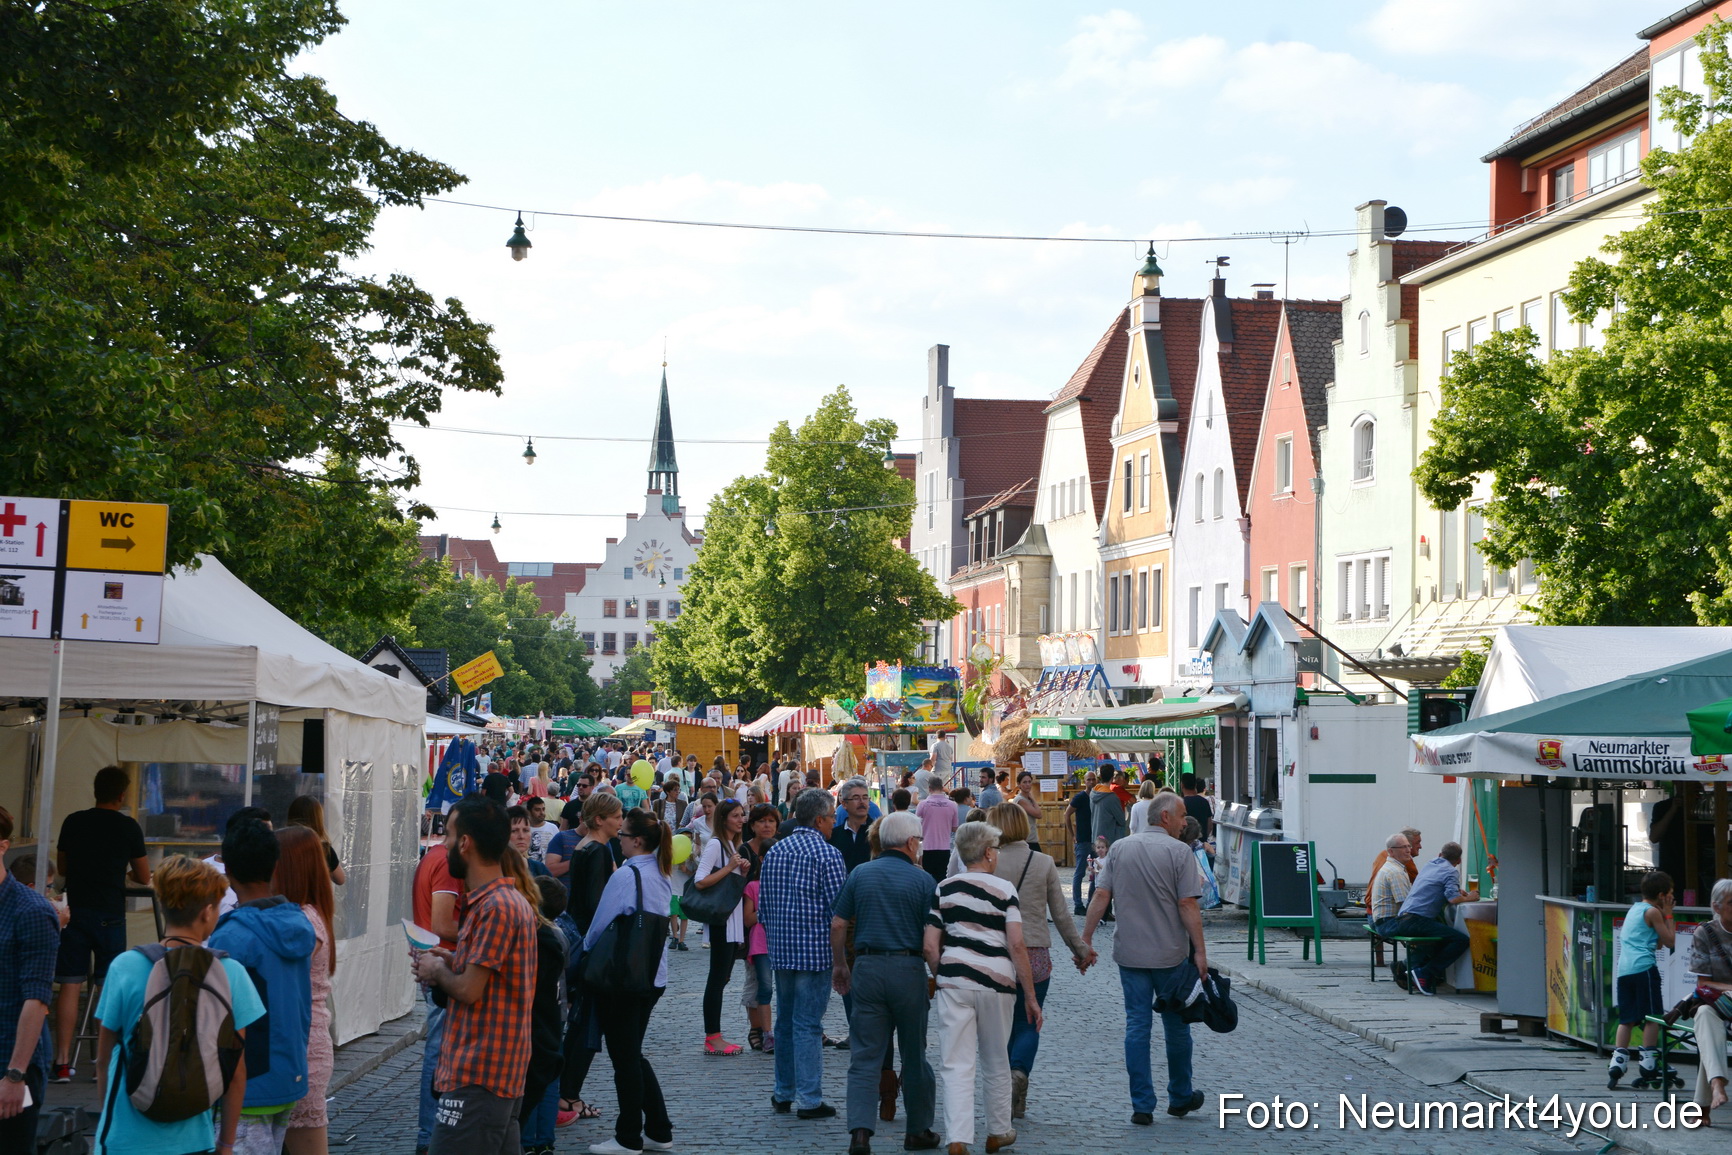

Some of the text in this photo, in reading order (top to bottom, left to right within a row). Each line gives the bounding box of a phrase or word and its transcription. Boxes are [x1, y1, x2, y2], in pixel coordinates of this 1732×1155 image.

[99, 511, 135, 528] WC
[1090, 724, 1216, 737] Neumarkter Lammsbräu
[1588, 740, 1671, 755] Neumarkter
[1439, 753, 1457, 765] MUSIC
[1456, 752, 1472, 764] STORE
[1572, 753, 1687, 775] Lammsbräu
[1295, 848, 1308, 872] now
[445, 1098, 465, 1108] CITY
